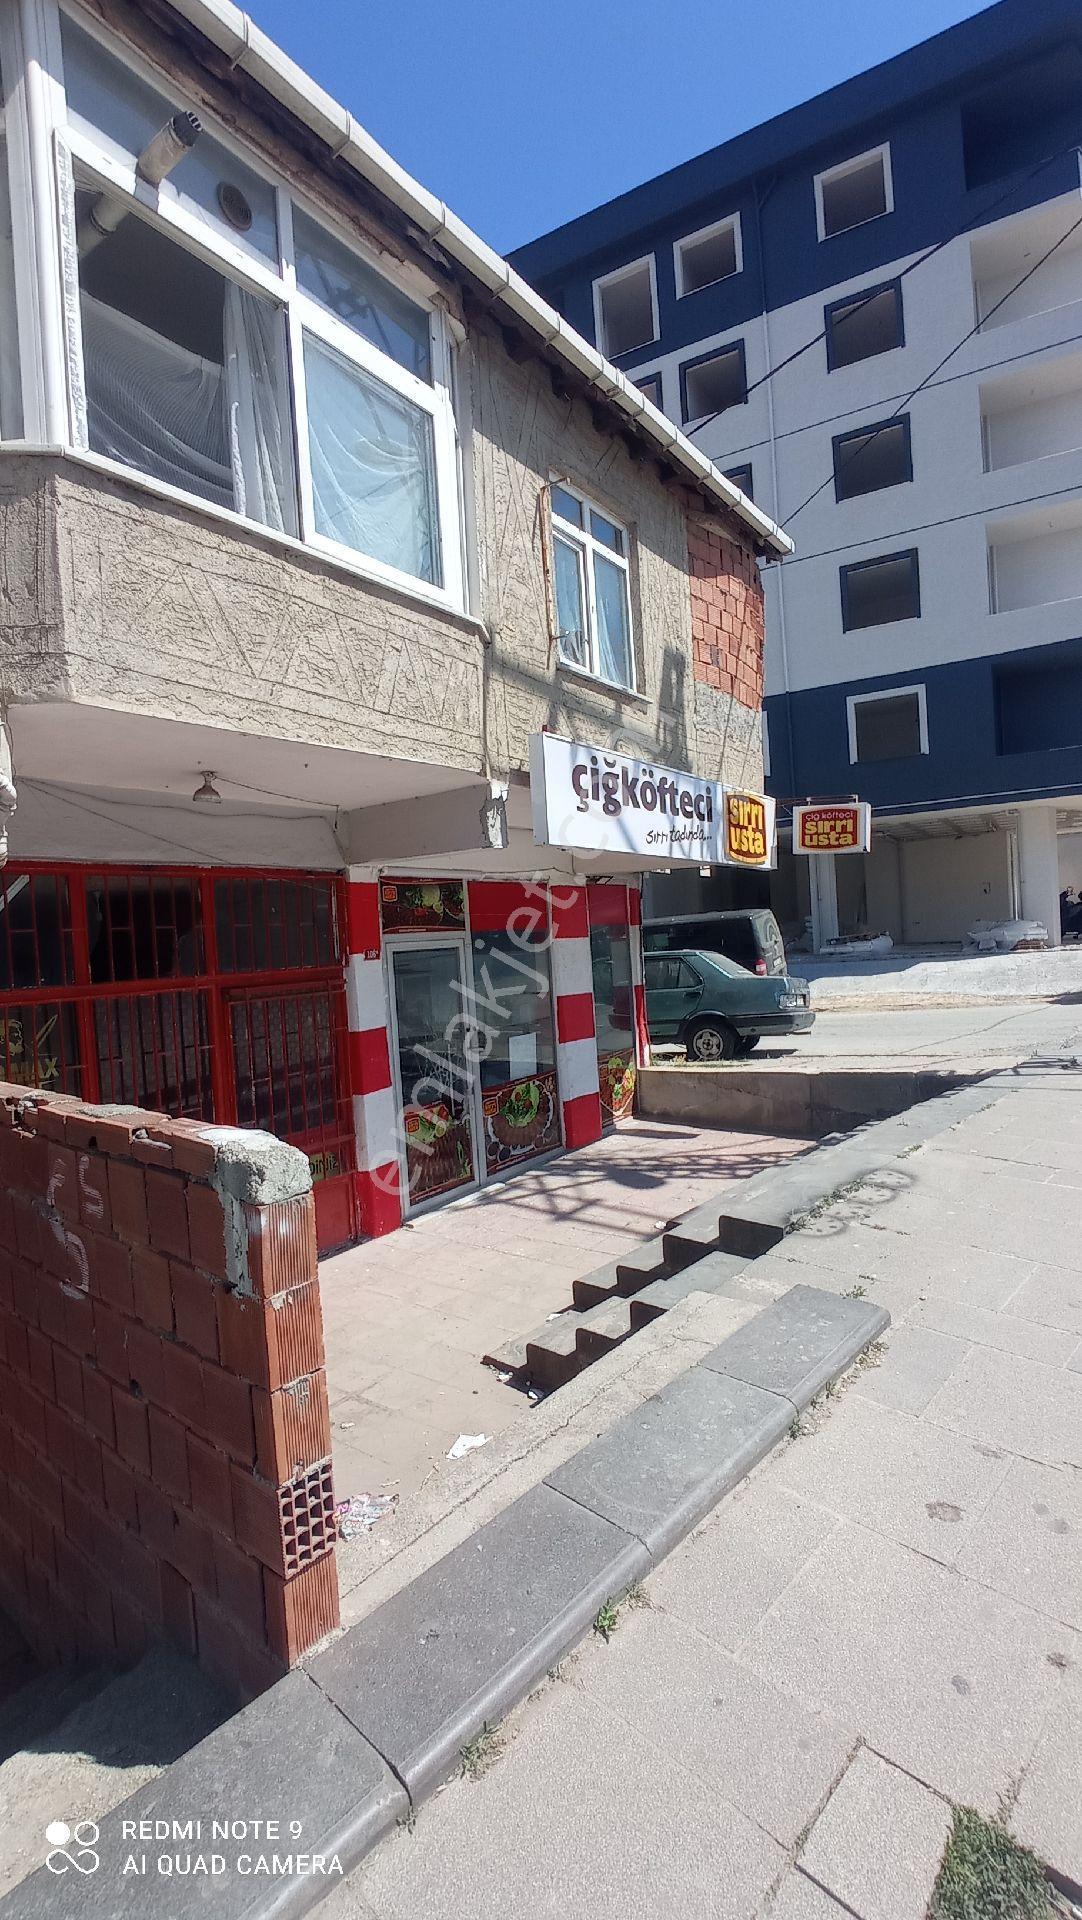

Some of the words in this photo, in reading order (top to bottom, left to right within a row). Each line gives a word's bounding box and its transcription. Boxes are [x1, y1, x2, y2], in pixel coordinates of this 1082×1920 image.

[571, 755, 713, 822] çiğköfteci
[730, 797, 764, 830] sırrı
[805, 819, 853, 834] sırrı
[730, 825, 764, 855] usta
[805, 831, 853, 846] usta
